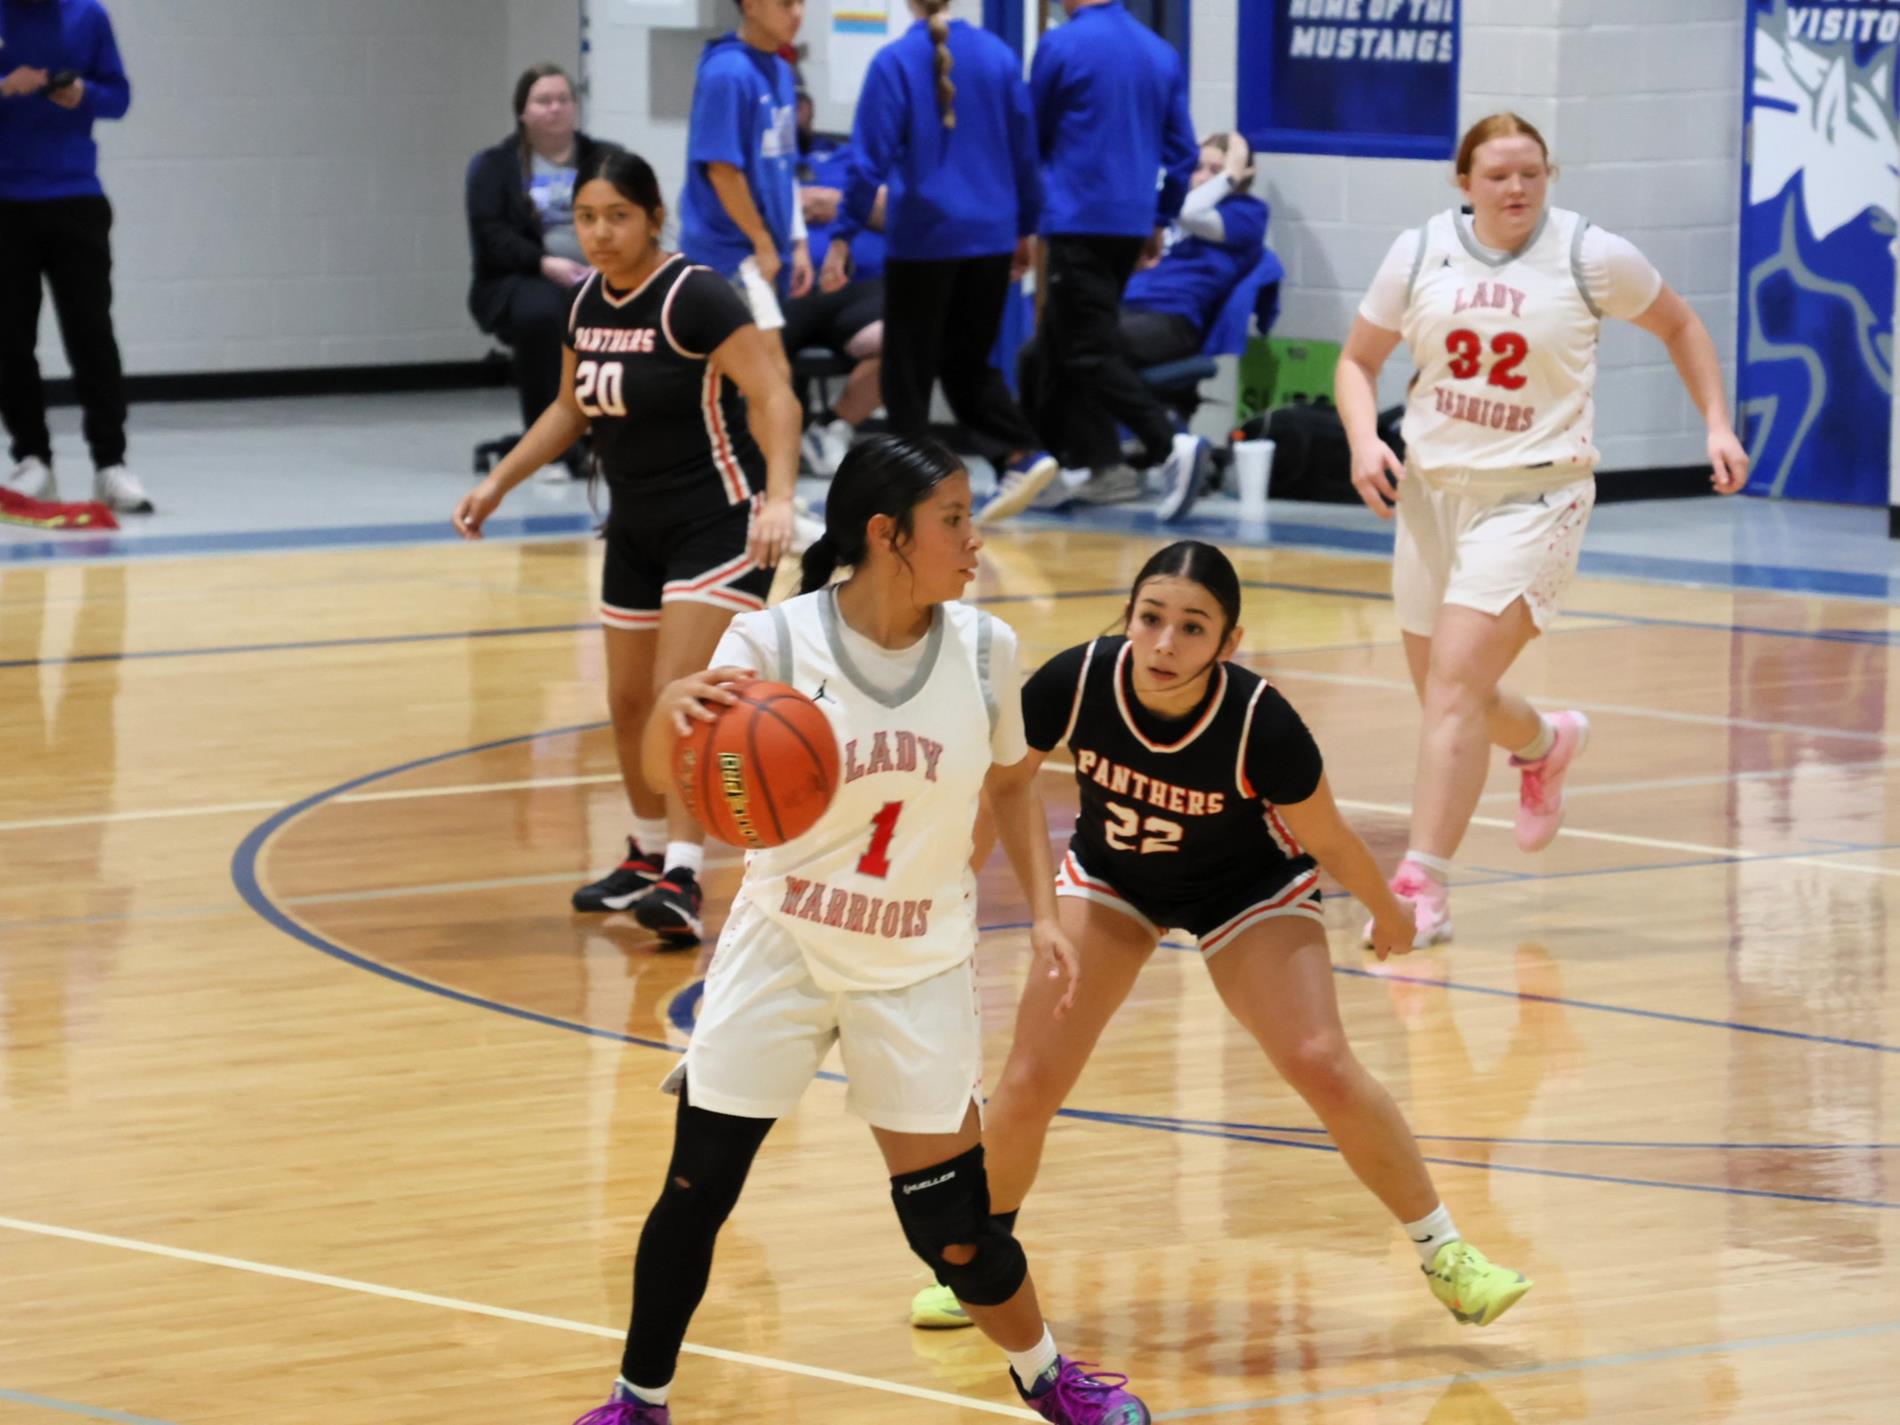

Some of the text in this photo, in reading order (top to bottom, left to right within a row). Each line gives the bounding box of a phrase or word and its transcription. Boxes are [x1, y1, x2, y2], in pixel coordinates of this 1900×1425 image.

[1290, 26, 1453, 62] MUSTANGS
[1453, 281, 1526, 318] LADY
[1445, 328, 1528, 391] 32
[575, 360, 627, 417] 20
[845, 730, 943, 784] LADY
[1078, 749, 1225, 816] PANTHERS
[855, 800, 904, 879] 1
[1104, 801, 1184, 854] 22
[780, 875, 933, 938] WARRIORS
